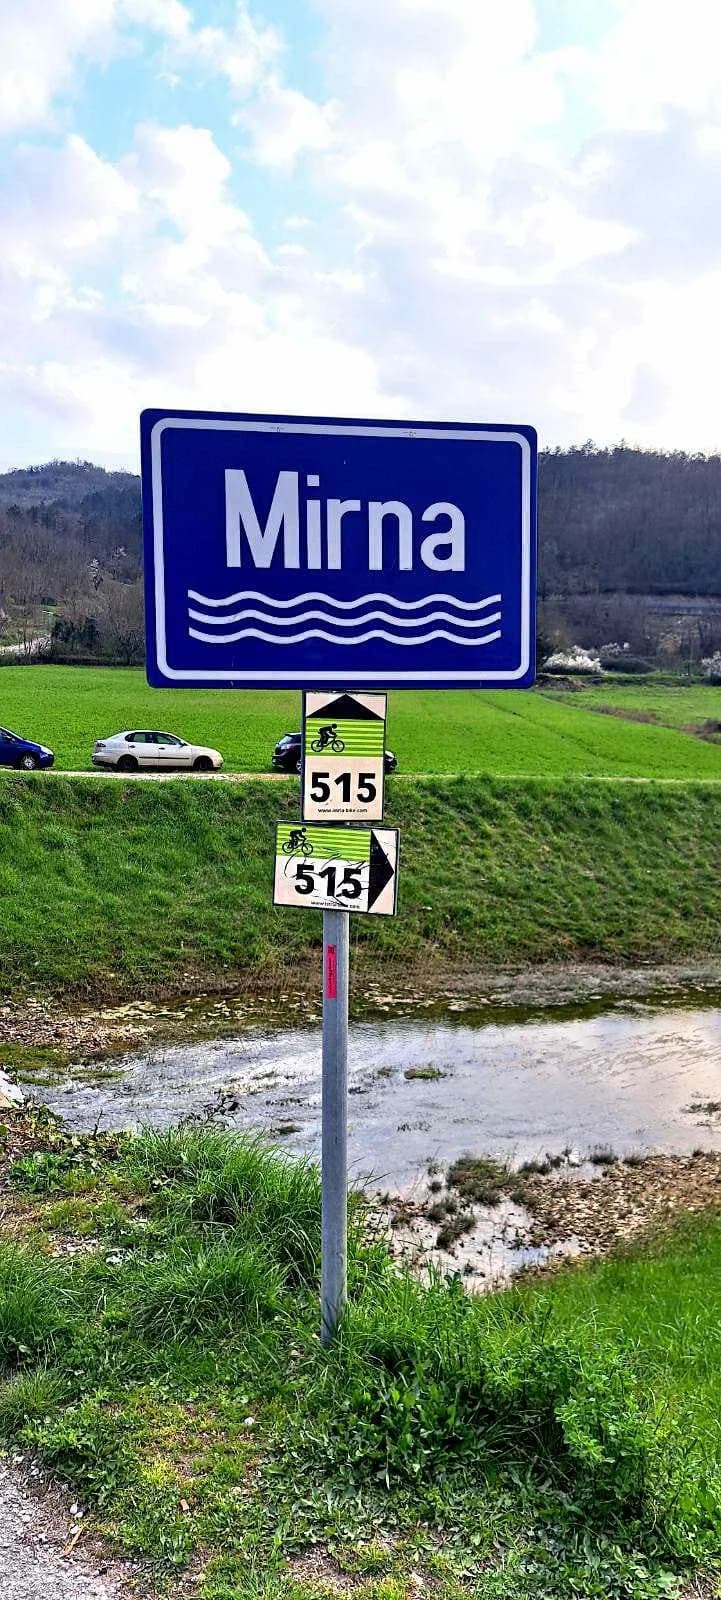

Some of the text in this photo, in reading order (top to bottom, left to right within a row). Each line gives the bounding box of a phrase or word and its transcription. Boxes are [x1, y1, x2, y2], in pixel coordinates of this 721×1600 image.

[225, 468, 466, 572] Mirna
[309, 772, 377, 804] 515
[294, 863, 363, 899] 515
